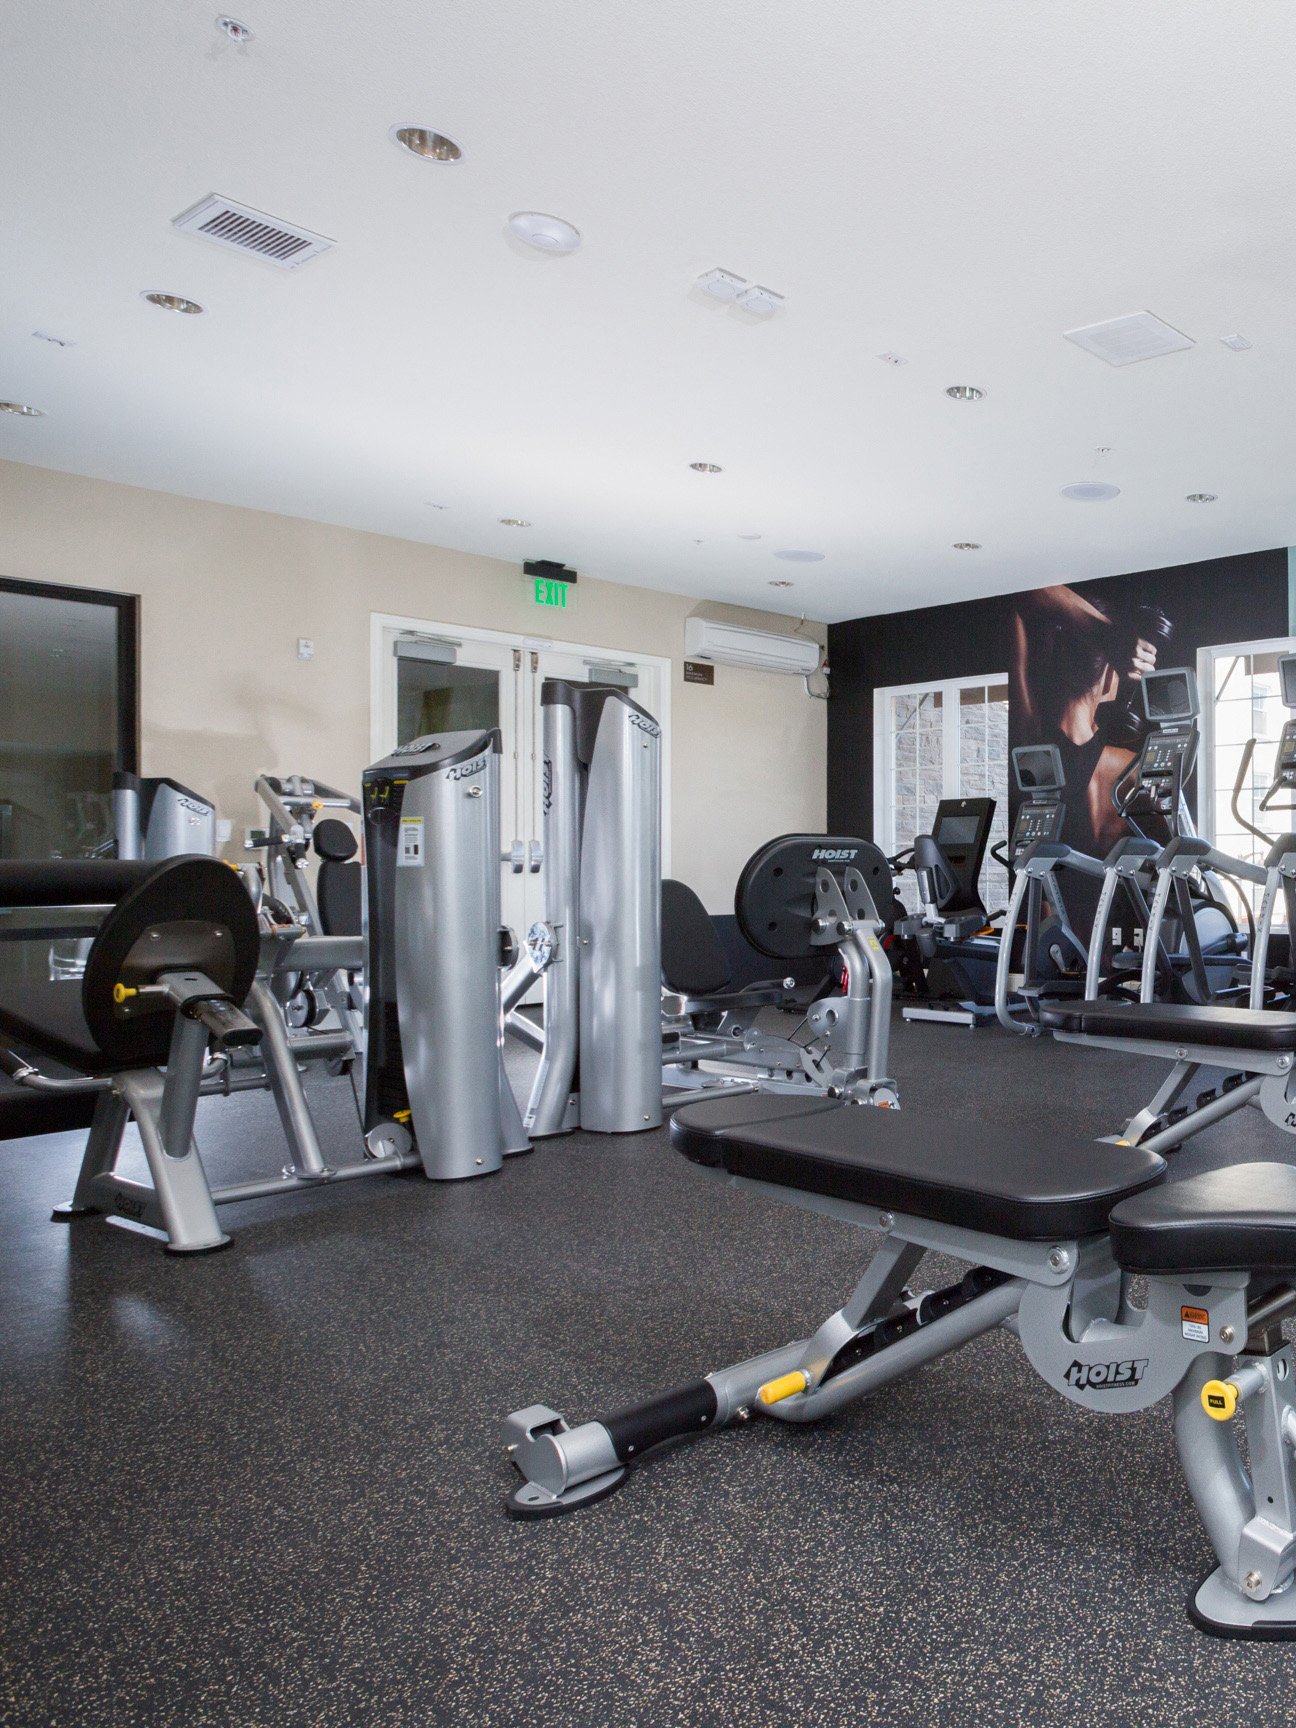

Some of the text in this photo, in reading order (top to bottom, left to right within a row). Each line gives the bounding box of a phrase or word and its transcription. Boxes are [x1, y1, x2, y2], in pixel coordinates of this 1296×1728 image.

[535, 579, 568, 607] EXIT
[446, 757, 488, 781] HOIS
[811, 849, 858, 860] HOIST
[1257, 892, 1271, 933] MATRIX
[1068, 1358, 1149, 1387] HOIST
